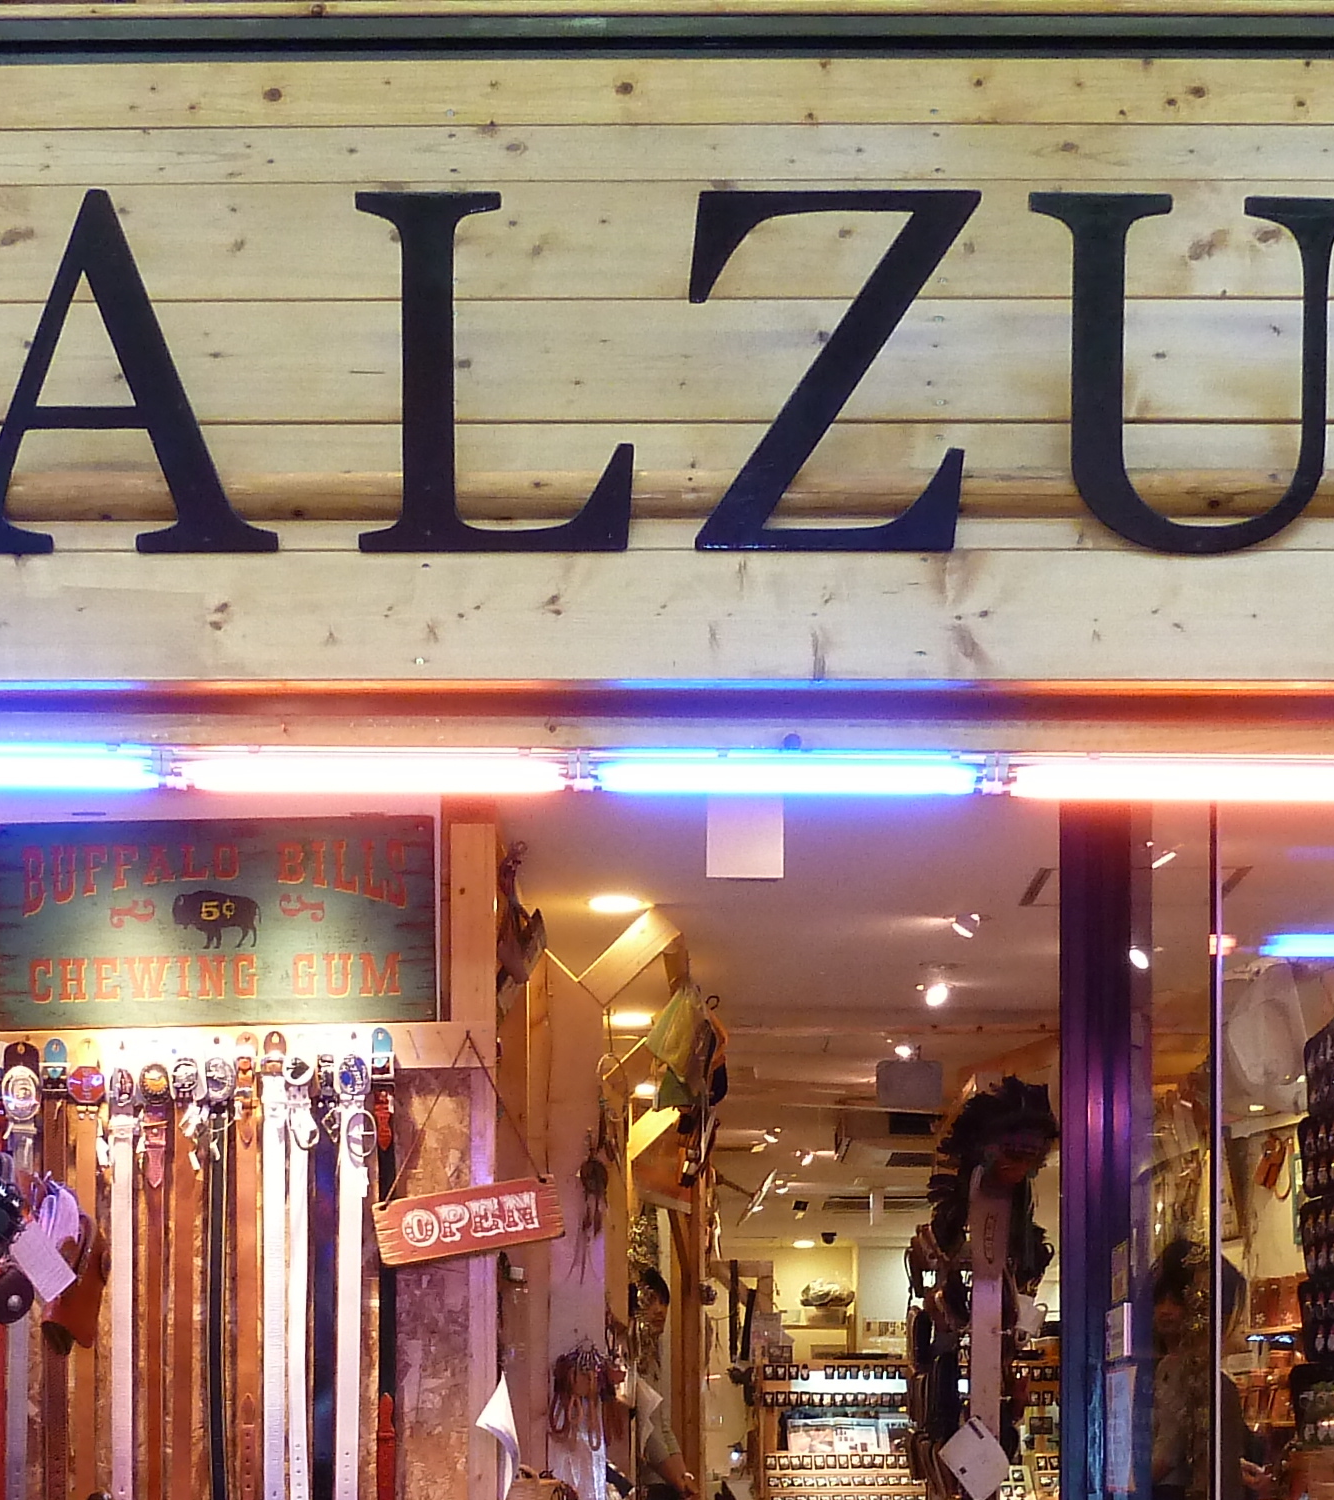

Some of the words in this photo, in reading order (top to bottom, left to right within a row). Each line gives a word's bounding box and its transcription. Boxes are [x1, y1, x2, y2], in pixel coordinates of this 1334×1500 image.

[22, 842, 240, 917] BUFFALO
[277, 838, 408, 909] BILLS
[200, 901, 235, 921] 5¢
[29, 954, 259, 1003] CHEWING
[292, 952, 401, 998] GUM
[402, 1190, 540, 1248] OPEN
